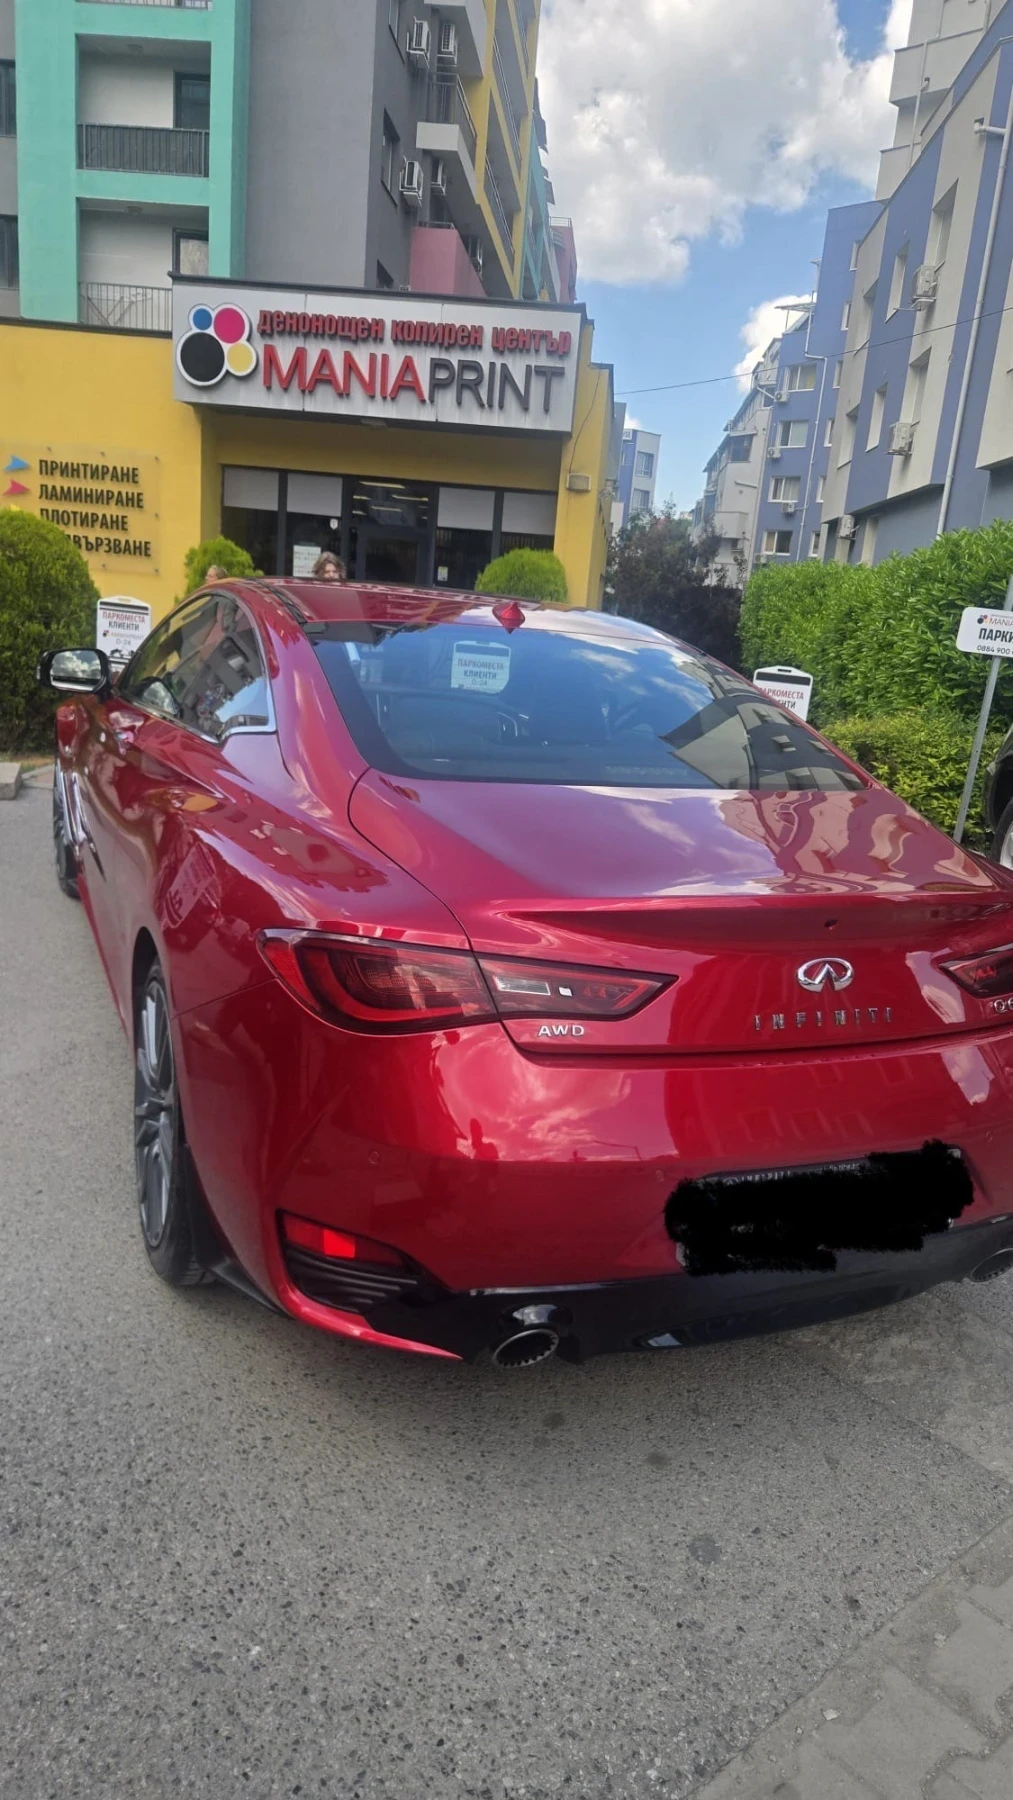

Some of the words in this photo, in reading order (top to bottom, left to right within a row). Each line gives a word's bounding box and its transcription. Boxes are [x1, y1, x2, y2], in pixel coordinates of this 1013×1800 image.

[257, 310, 385, 342] денонощен
[391, 320, 483, 349] копирен
[492, 327, 572, 357] център
[263, 344, 566, 413] MANIAPRINT
[38, 459, 139, 484] ПРИНТИРАНЕ
[38, 484, 144, 509] ЛАМИНИРАНЕ
[102, 611, 146, 623] ПАРКОМЕСТА
[108, 621, 140, 631] КЛИЕНТИ
[457, 659, 504, 670] ПАРКОМЕСТА
[464, 670, 497, 680] КЛИЕНТИ
[754, 1007, 892, 1031] INFINITI
[537, 1024, 585, 1037] AWD
